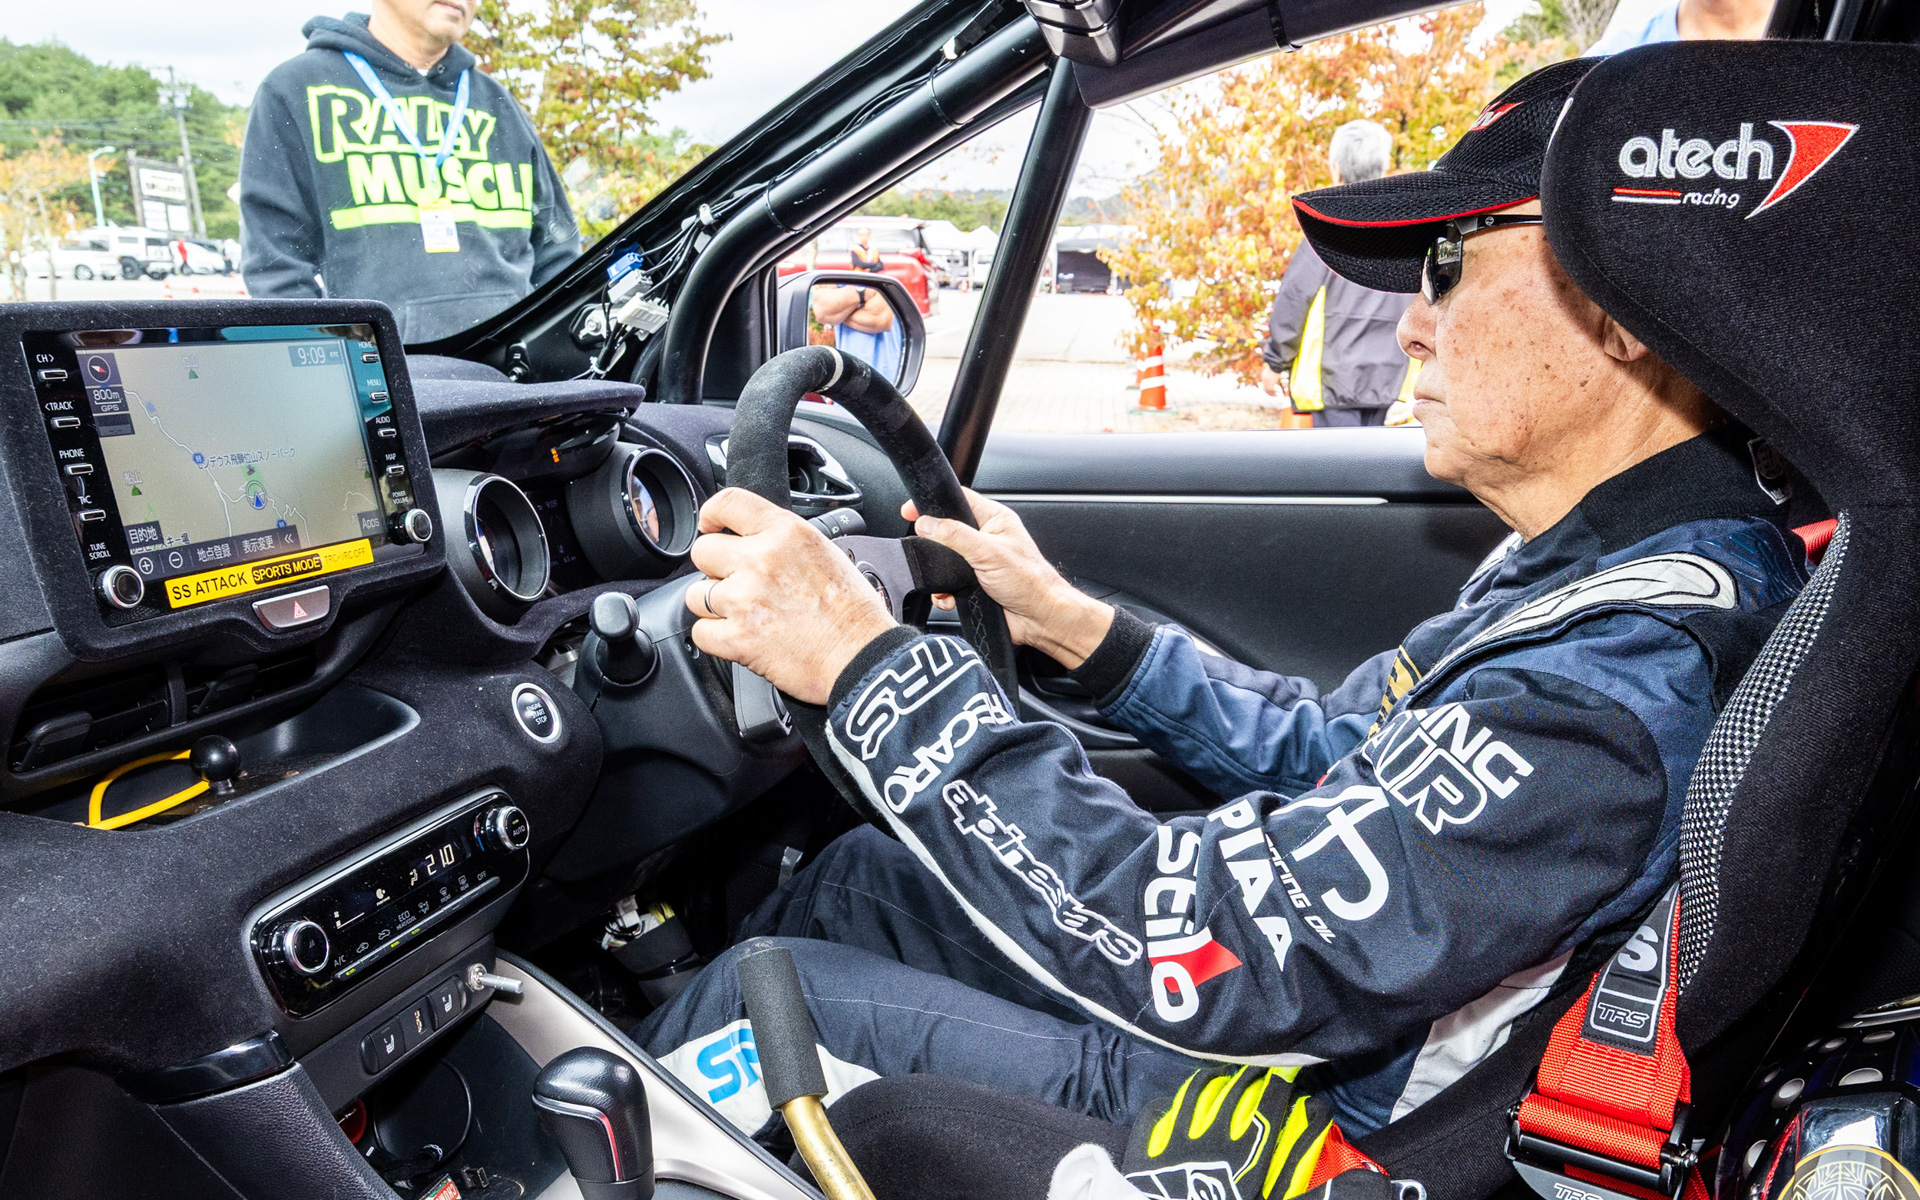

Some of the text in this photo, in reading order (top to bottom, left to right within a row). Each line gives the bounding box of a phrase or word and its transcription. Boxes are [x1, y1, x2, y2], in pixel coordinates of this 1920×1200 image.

[307, 85, 496, 163] RALLY
[1618, 122, 1774, 180] atech
[1683, 188, 1740, 209] racing
[358, 341, 374, 349] HOME
[297, 346, 326, 365] 9:09
[366, 379, 382, 387] MENU
[92, 389, 120, 401] 800m
[375, 415, 391, 425] AUDIO
[58, 448, 86, 459] PHONE
[385, 453, 397, 461] MAP
[361, 517, 380, 530] Apps
[127, 525, 159, 545] 目的地
[89, 542, 107, 551] TUNE
[241, 535, 276, 554] 表示変更
[88, 549, 112, 561] SCROLL
[196, 544, 232, 563] 地点登録
[172, 584, 192, 600] SS
[195, 571, 249, 596] ATTACK
[252, 560, 293, 582] SPORTS
[291, 555, 322, 573] MODE
[534, 715, 548, 726] STOP
[883, 692, 1014, 814] RECARO
[512, 825, 527, 837] AUTO
[476, 870, 488, 882] OFF
[1206, 799, 1293, 973] PIAA
[397, 909, 411, 922] ECO
[333, 956, 347, 967] A/C
[1597, 1002, 1650, 1029] TRS
